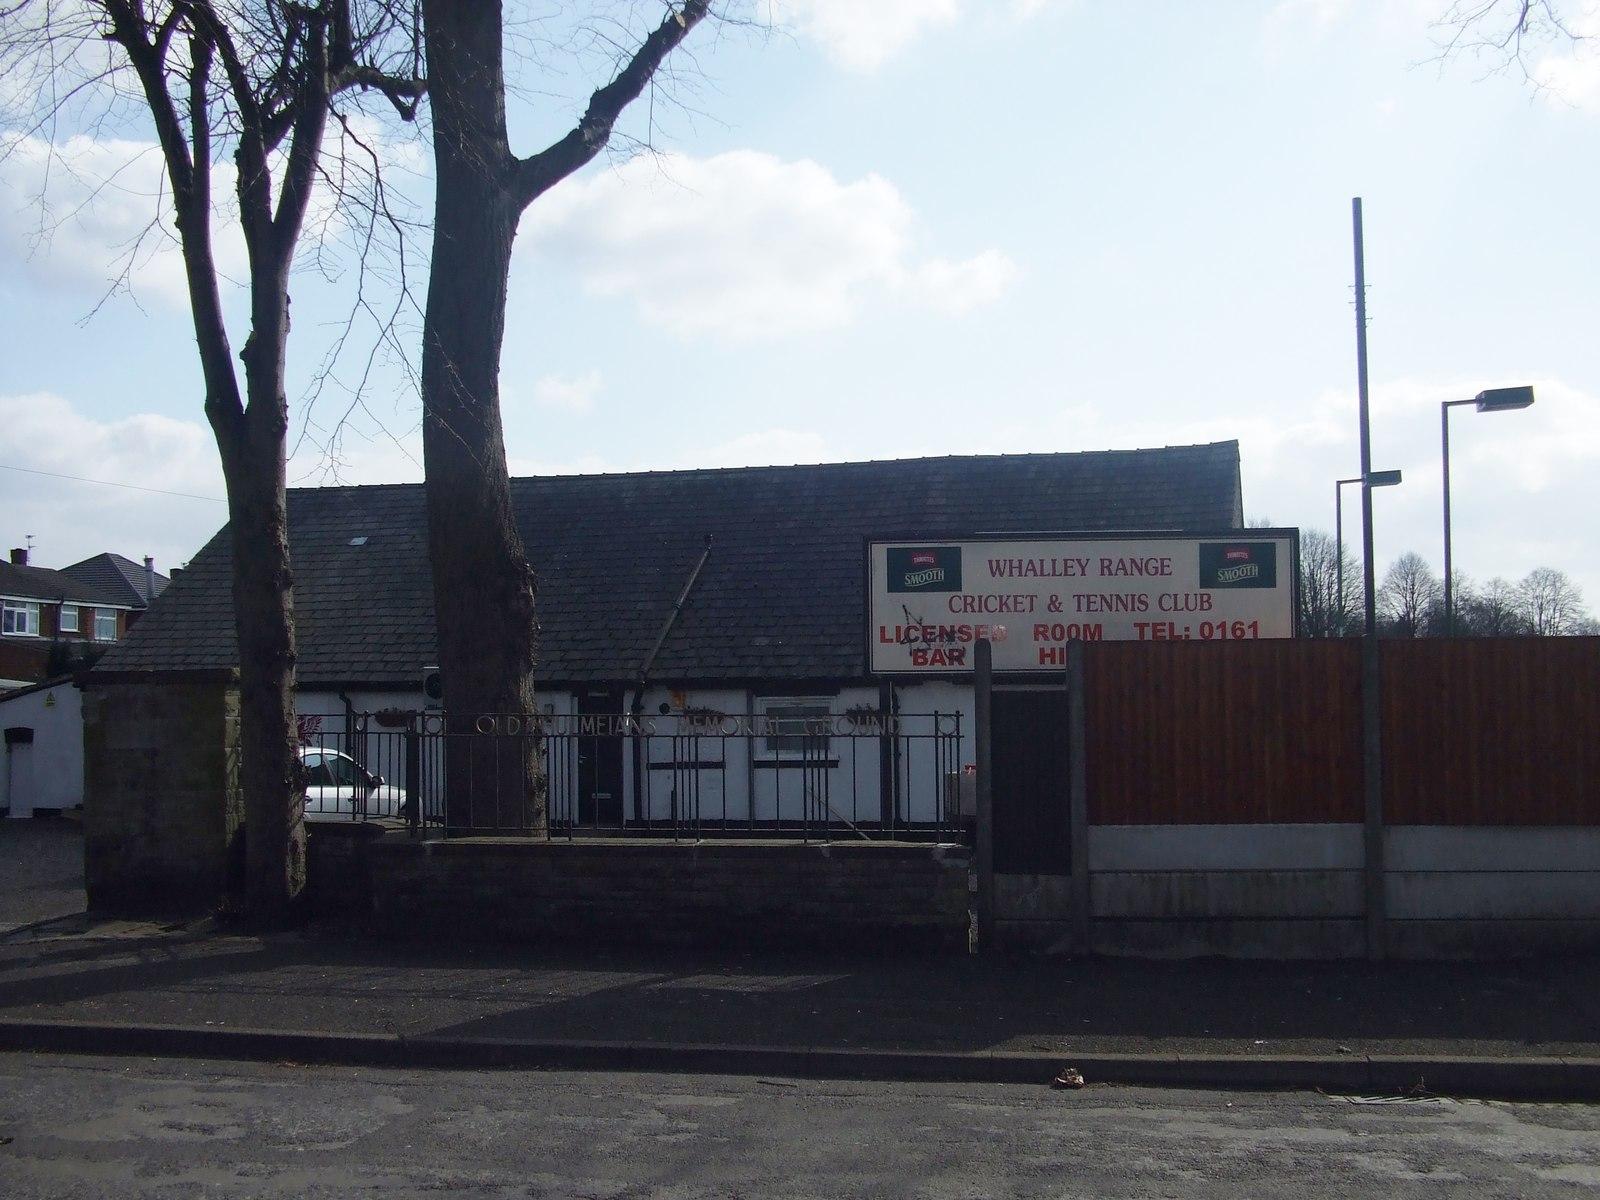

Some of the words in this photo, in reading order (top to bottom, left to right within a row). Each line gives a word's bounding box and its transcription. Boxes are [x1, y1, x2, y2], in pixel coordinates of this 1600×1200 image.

[988, 558, 1091, 578] WHALLEY
[1099, 557, 1173, 577] RANGE
[1216, 565, 1259, 582] SMOOTH
[904, 569, 945, 586] SMOOTH
[948, 594, 1038, 614] CRICKET
[1047, 594, 1064, 613] &
[1073, 593, 1149, 613] TENNIS
[1158, 592, 1213, 612] CLUB
[1033, 623, 1103, 641] ROOM
[1133, 621, 1190, 640] TEL:
[1199, 620, 1259, 640] 0161
[912, 648, 966, 666] BAR
[1039, 647, 1067, 665] HI
